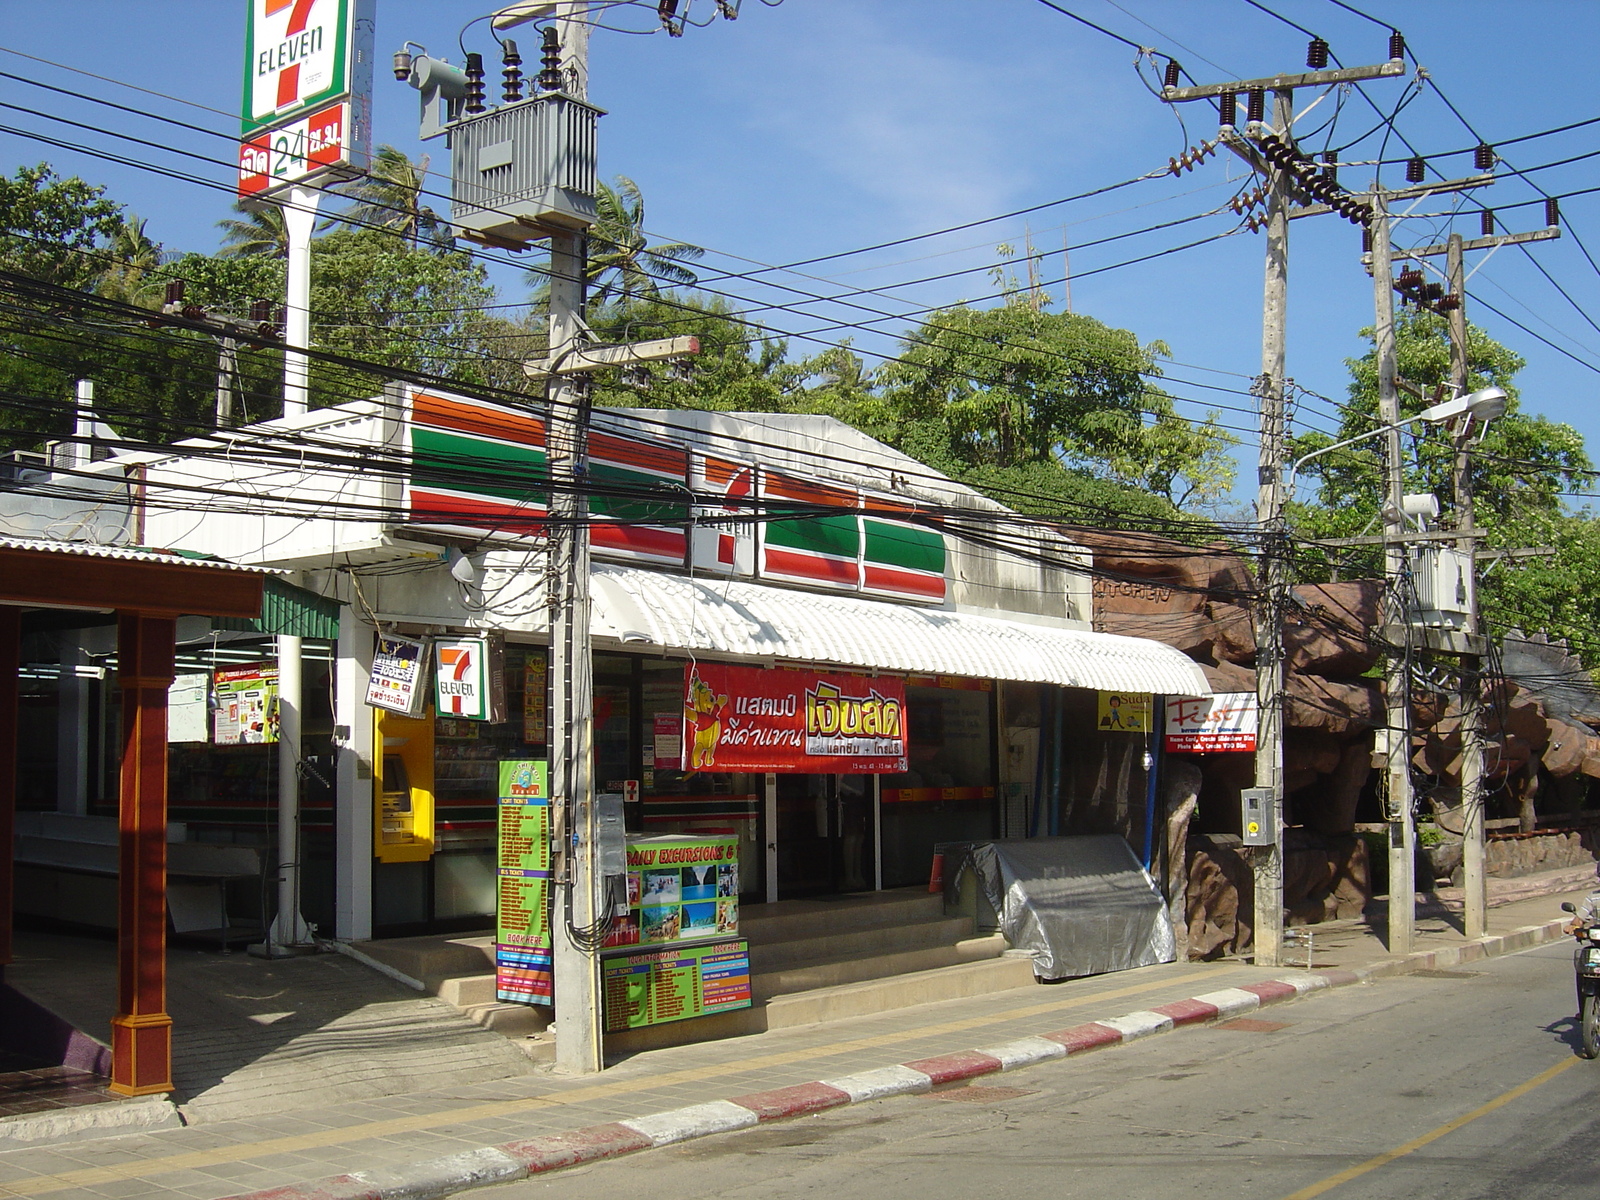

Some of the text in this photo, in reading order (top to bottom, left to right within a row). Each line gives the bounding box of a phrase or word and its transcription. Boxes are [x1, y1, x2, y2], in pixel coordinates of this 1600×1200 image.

[273, 128, 305, 177] 24
[807, 682, 900, 738] เงินสด
[1120, 693, 1150, 704] Suda
[1167, 697, 1257, 726] First
[720, 717, 804, 748] มีค่าแทน
[626, 849, 656, 866] DAILY
[659, 845, 724, 864] EXCURSIONS
[507, 934, 543, 945] BOOK HERE
